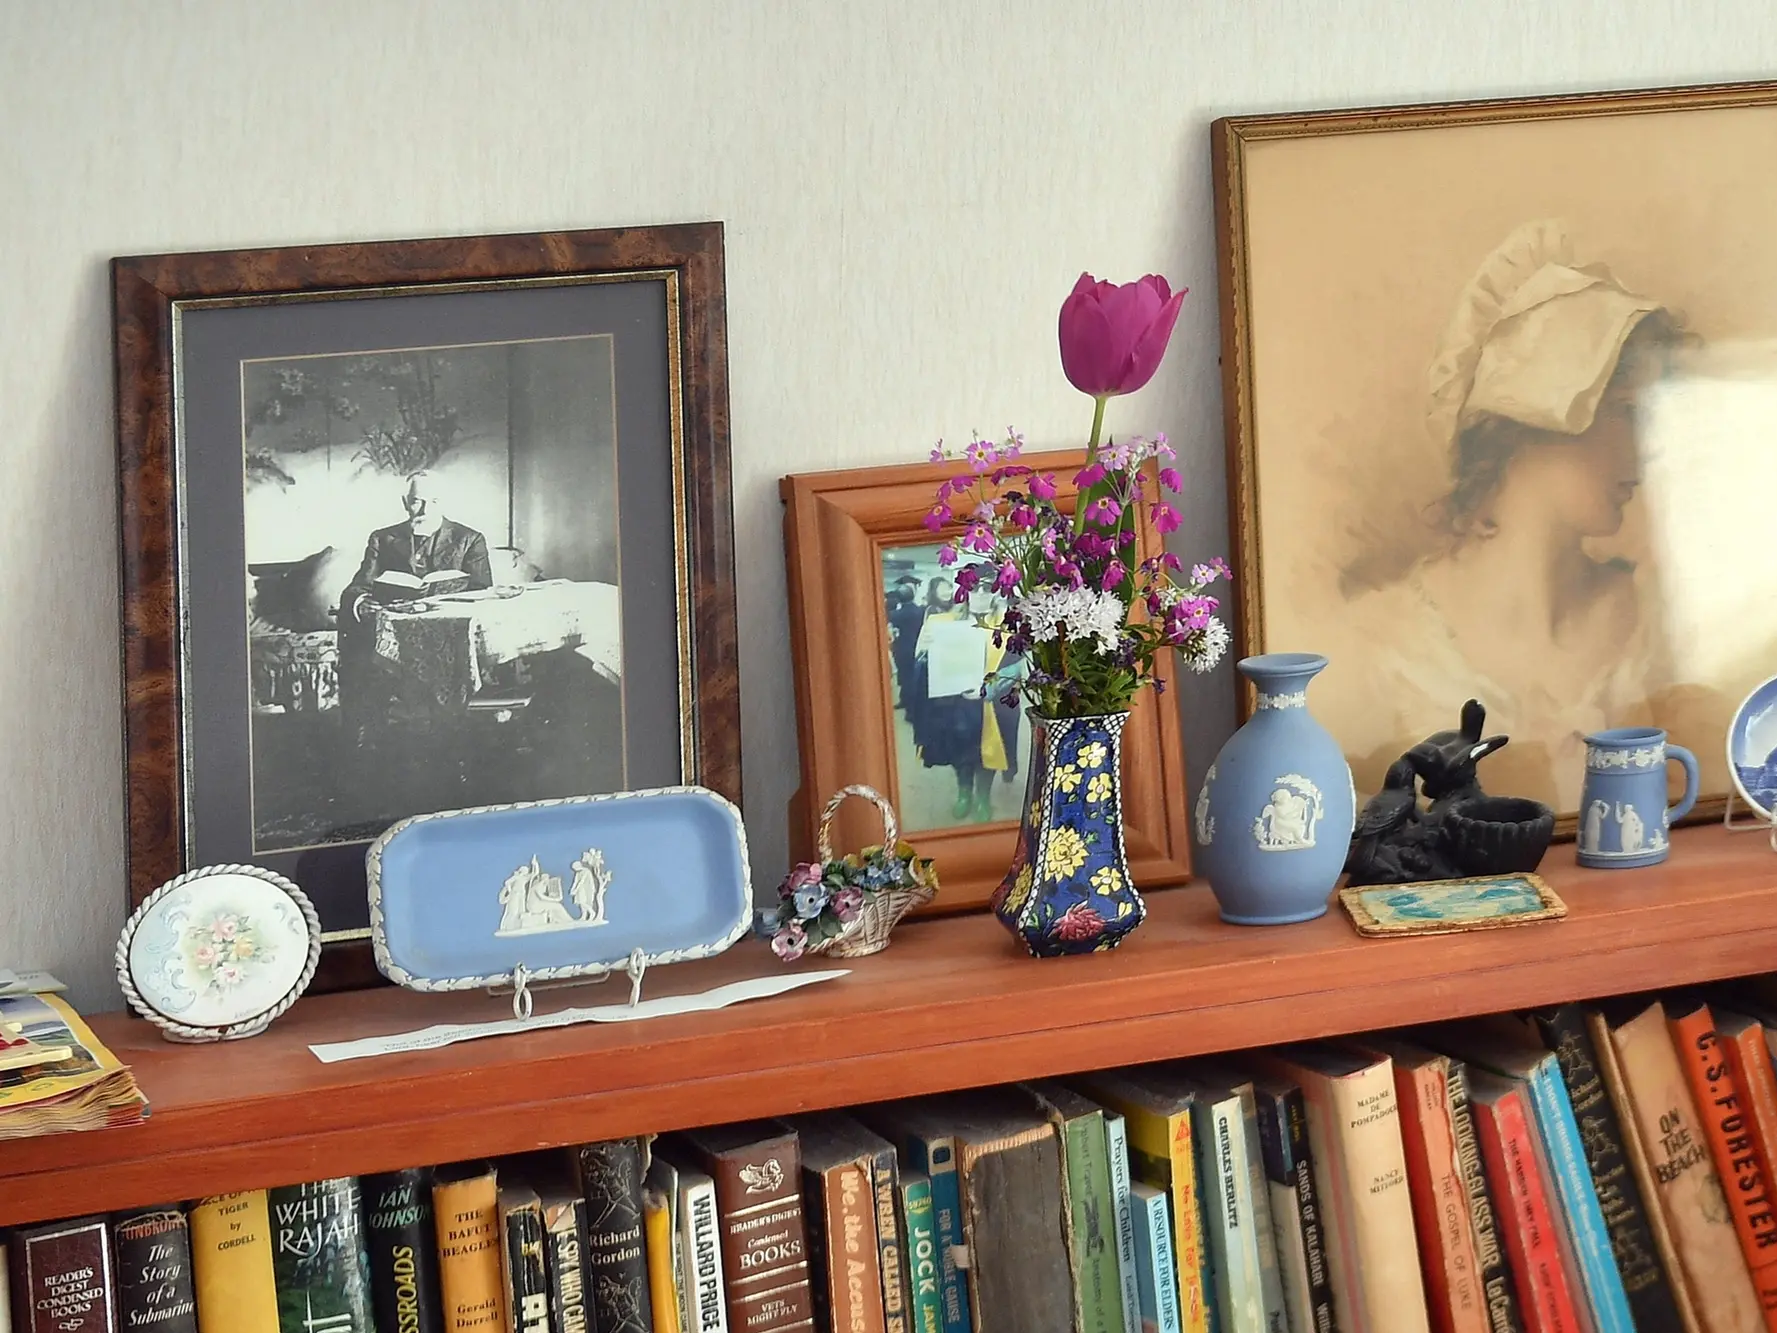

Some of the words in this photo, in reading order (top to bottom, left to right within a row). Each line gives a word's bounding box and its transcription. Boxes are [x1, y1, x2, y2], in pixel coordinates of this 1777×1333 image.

[1357, 1090, 1390, 1109] MADAME
[1370, 1103, 1381, 1113] DE
[1659, 1108, 1681, 1135] ON
[1218, 1116, 1233, 1174] CHARLES
[1660, 1131, 1692, 1154] THE
[1111, 1136, 1125, 1184] Prayers
[1447, 1072, 1465, 1102] THE
[1478, 1227, 1501, 1269] WAR
[1656, 1146, 1707, 1184] BEACH
[876, 1168, 891, 1182] A
[1296, 1159, 1312, 1202] SANDS
[1440, 1172, 1454, 1198] THE
[275, 1187, 362, 1226] WHITE
[379, 1187, 413, 1207] IAN
[1117, 1185, 1130, 1205] for
[1224, 1174, 1238, 1229] BERLITZ
[218, 1202, 249, 1216] TIGER
[455, 1209, 485, 1222] THE
[878, 1182, 897, 1240] WREN
[1302, 1204, 1315, 1222] OF
[230, 1222, 242, 1232] by
[279, 1213, 359, 1256] RAJAH
[448, 1224, 491, 1241] BAFUT
[589, 1227, 640, 1246] Richard
[693, 1194, 716, 1277] WILLARD
[844, 1214, 864, 1253] the
[1118, 1206, 1134, 1262] Children
[1154, 1206, 1169, 1264] RESOURCE
[1444, 1203, 1461, 1250] GOSPEL
[217, 1234, 256, 1251] CORDELL
[748, 1230, 789, 1250] Condensed
[148, 1244, 174, 1263] The
[557, 1240, 583, 1271] SPY
[591, 1246, 641, 1265] Gordon
[739, 1240, 801, 1270] BOOKS
[914, 1226, 936, 1295] JOCK
[1305, 1224, 1324, 1287] KALAHARI
[1453, 1255, 1465, 1273] OF
[45, 1266, 94, 1287] READER'S
[139, 1263, 182, 1285] Story
[883, 1244, 903, 1312] CALLED
[1160, 1265, 1172, 1288] FOR
[37, 1287, 104, 1310] CONDENSED
[51, 1279, 89, 1297] DIGEST
[146, 1284, 166, 1305] of
[166, 1288, 175, 1299] a
[560, 1268, 584, 1306] WHO
[1457, 1278, 1473, 1311] LUKE
[51, 1301, 92, 1318] BOOKS
[457, 1298, 497, 1314] Gerald
[700, 1277, 720, 1332] PRICE
[1161, 1289, 1175, 1331] ELDERS
[456, 1312, 498, 1329] Durrell
